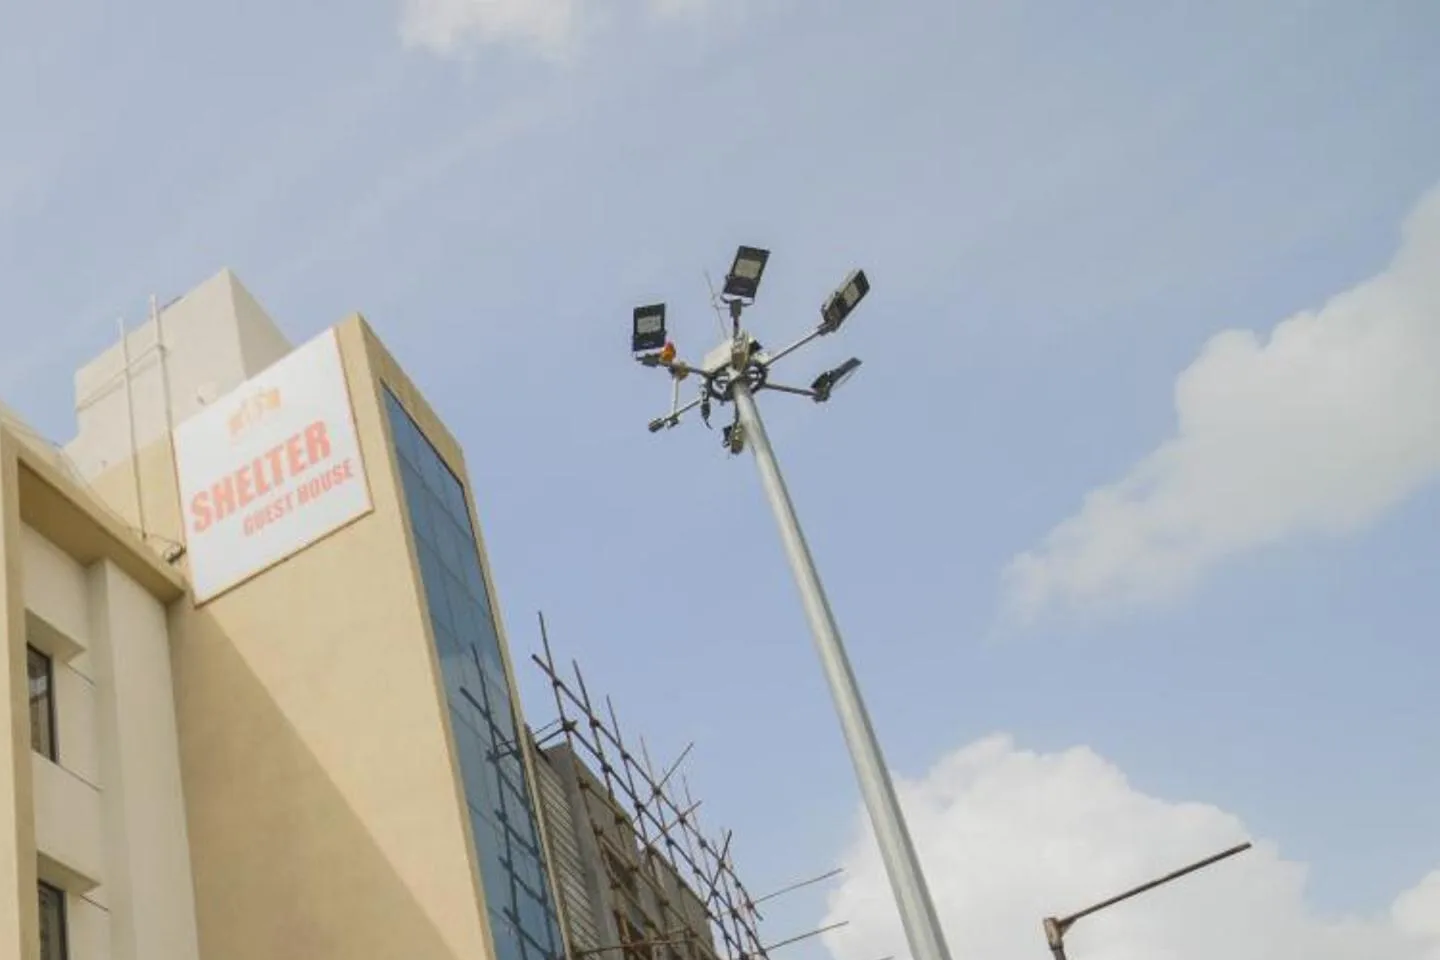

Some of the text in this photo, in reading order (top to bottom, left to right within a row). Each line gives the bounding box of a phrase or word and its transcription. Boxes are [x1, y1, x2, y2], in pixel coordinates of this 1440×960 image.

[190, 420, 331, 533] SHELTER
[242, 457, 354, 537] GUEST HOUSE
